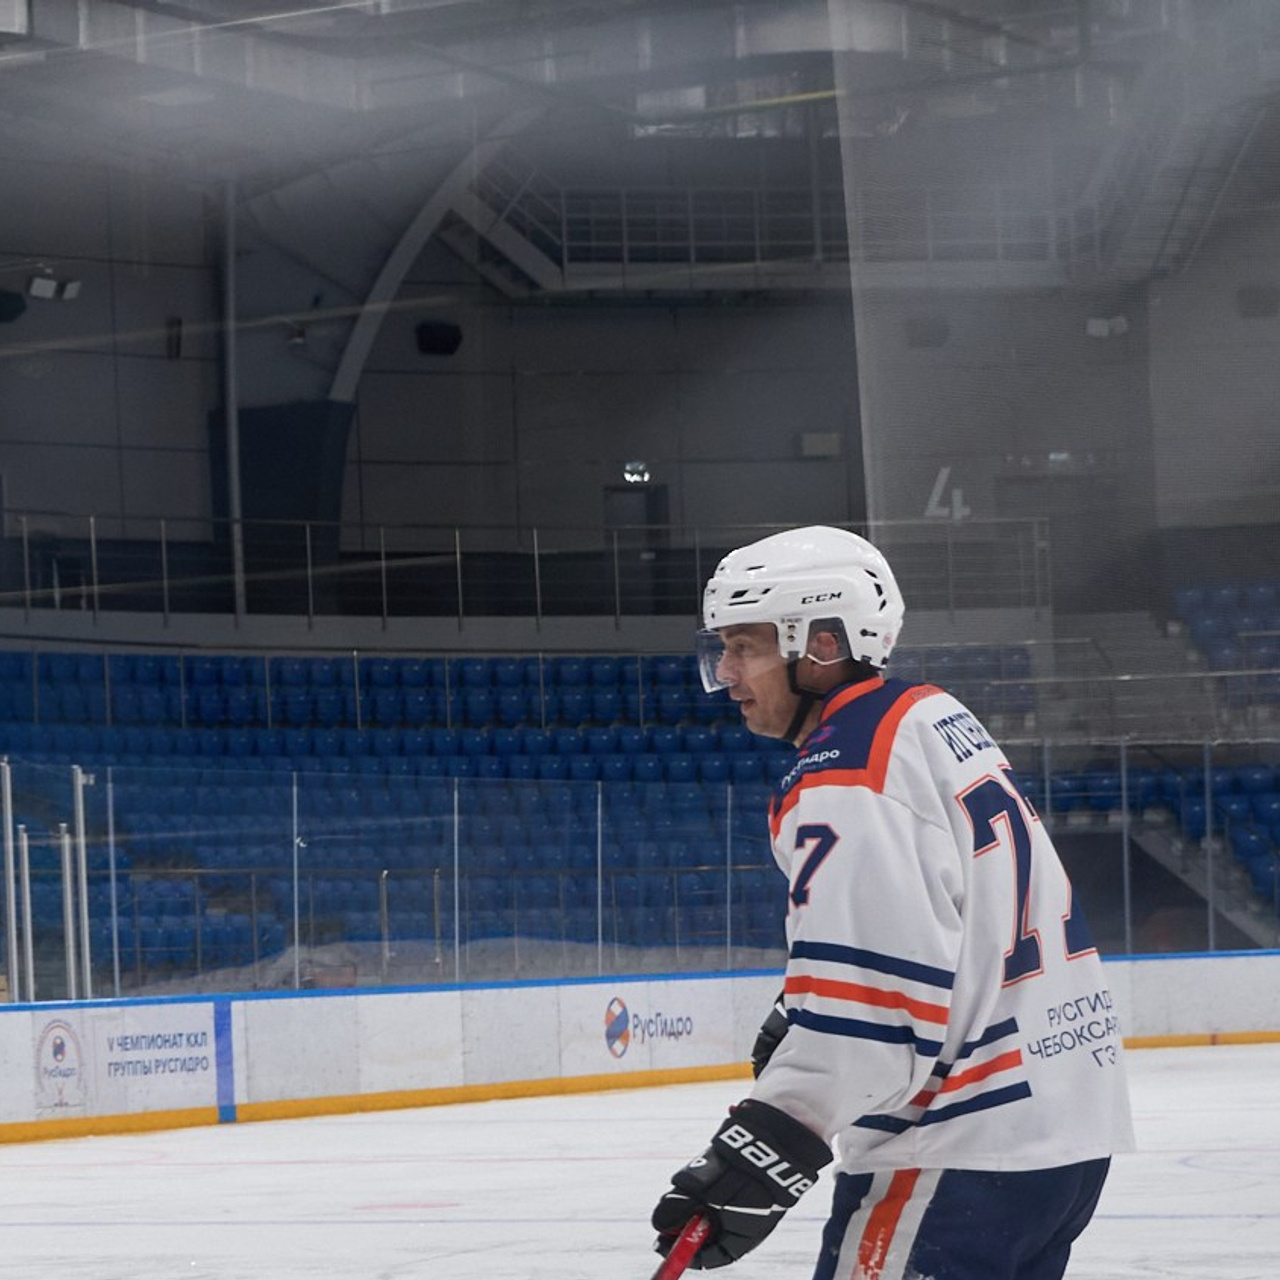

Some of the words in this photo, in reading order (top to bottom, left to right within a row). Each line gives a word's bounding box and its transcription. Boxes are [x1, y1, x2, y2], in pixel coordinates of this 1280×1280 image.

[924, 467, 971, 525] 4
[801, 591, 842, 605] CCM
[632, 1012, 693, 1044] РусГидро
[116, 1032, 184, 1052] ЧЕМПИОНАТ
[107, 1059, 153, 1077] ГРУППЫ
[154, 1056, 209, 1075] РУСГИДРО
